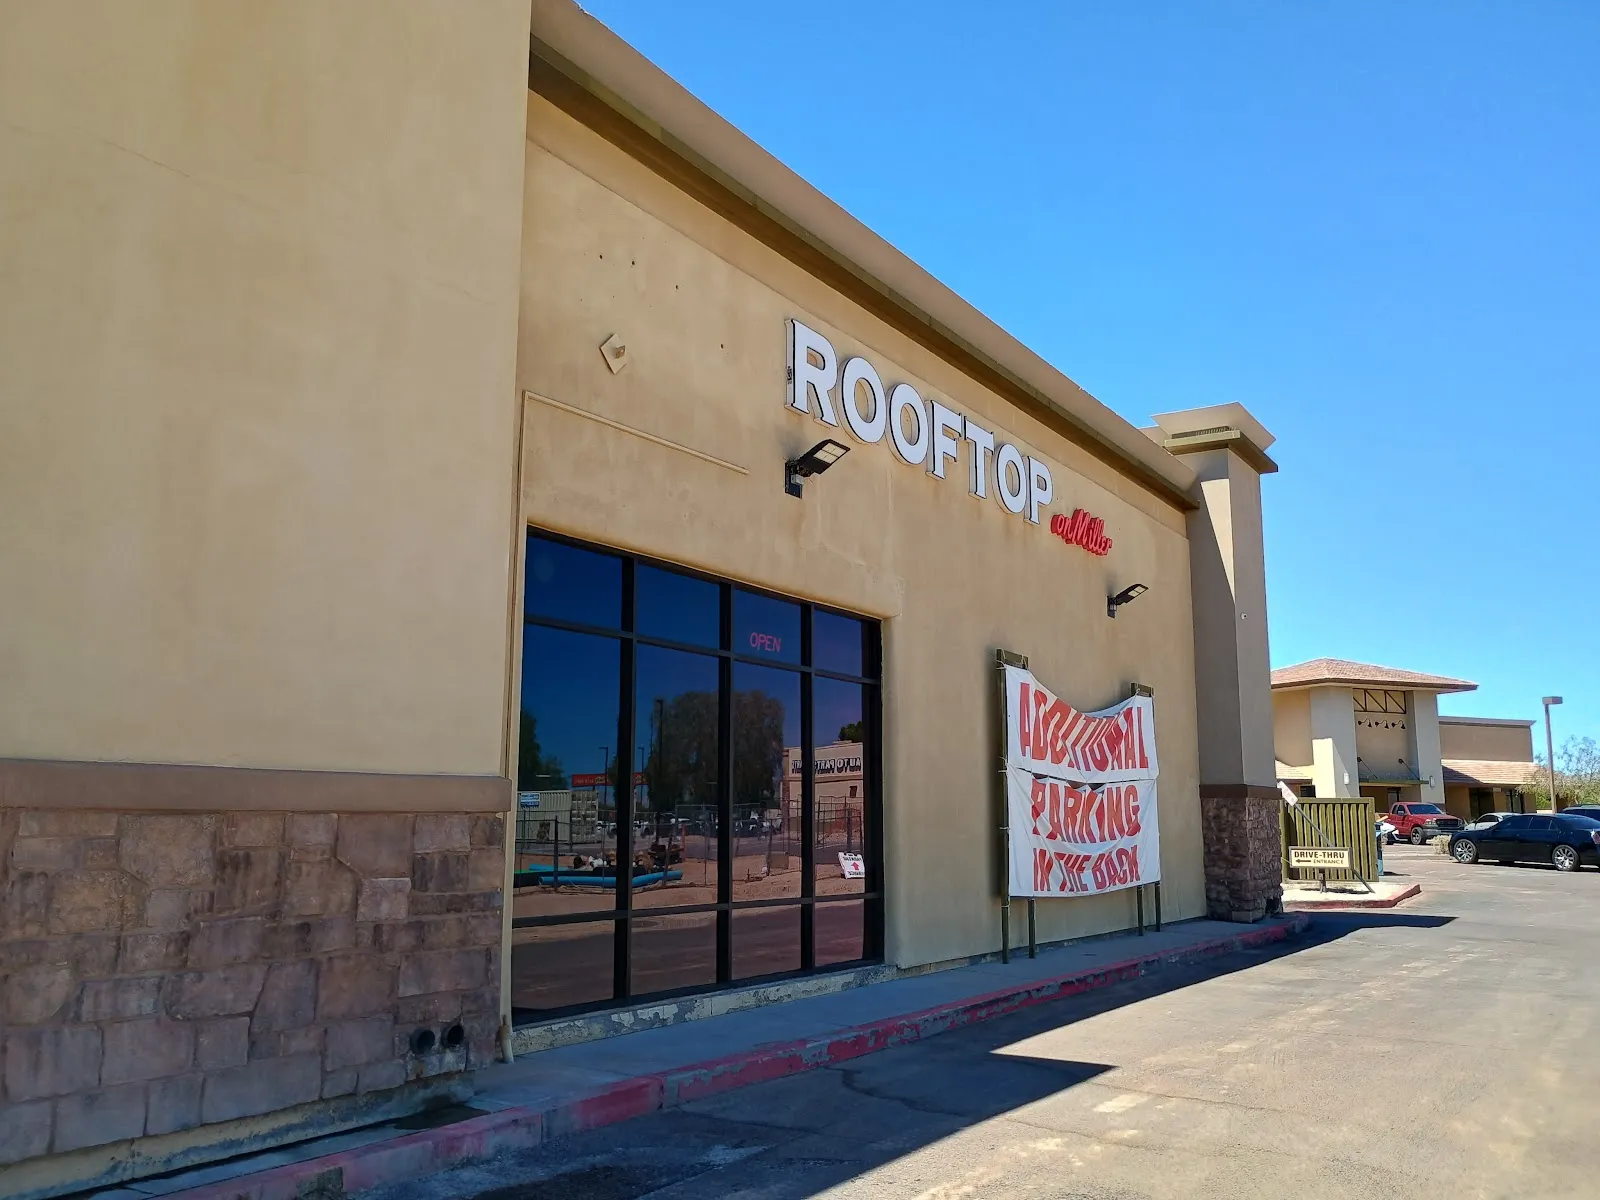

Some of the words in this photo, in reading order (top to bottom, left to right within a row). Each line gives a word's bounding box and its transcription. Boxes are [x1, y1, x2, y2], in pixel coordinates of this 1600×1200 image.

[785, 318, 1053, 524] ROOFTOP
[1070, 508, 1112, 555] Miller
[750, 632, 781, 652] OPEN
[1020, 682, 1149, 772] ADDITIONAL
[1031, 778, 1141, 843] PARKING
[1033, 848, 1053, 892] IN
[1054, 852, 1092, 892] THE
[1092, 845, 1140, 890] BACK
[1294, 851, 1345, 859] DRIVE-THRU
